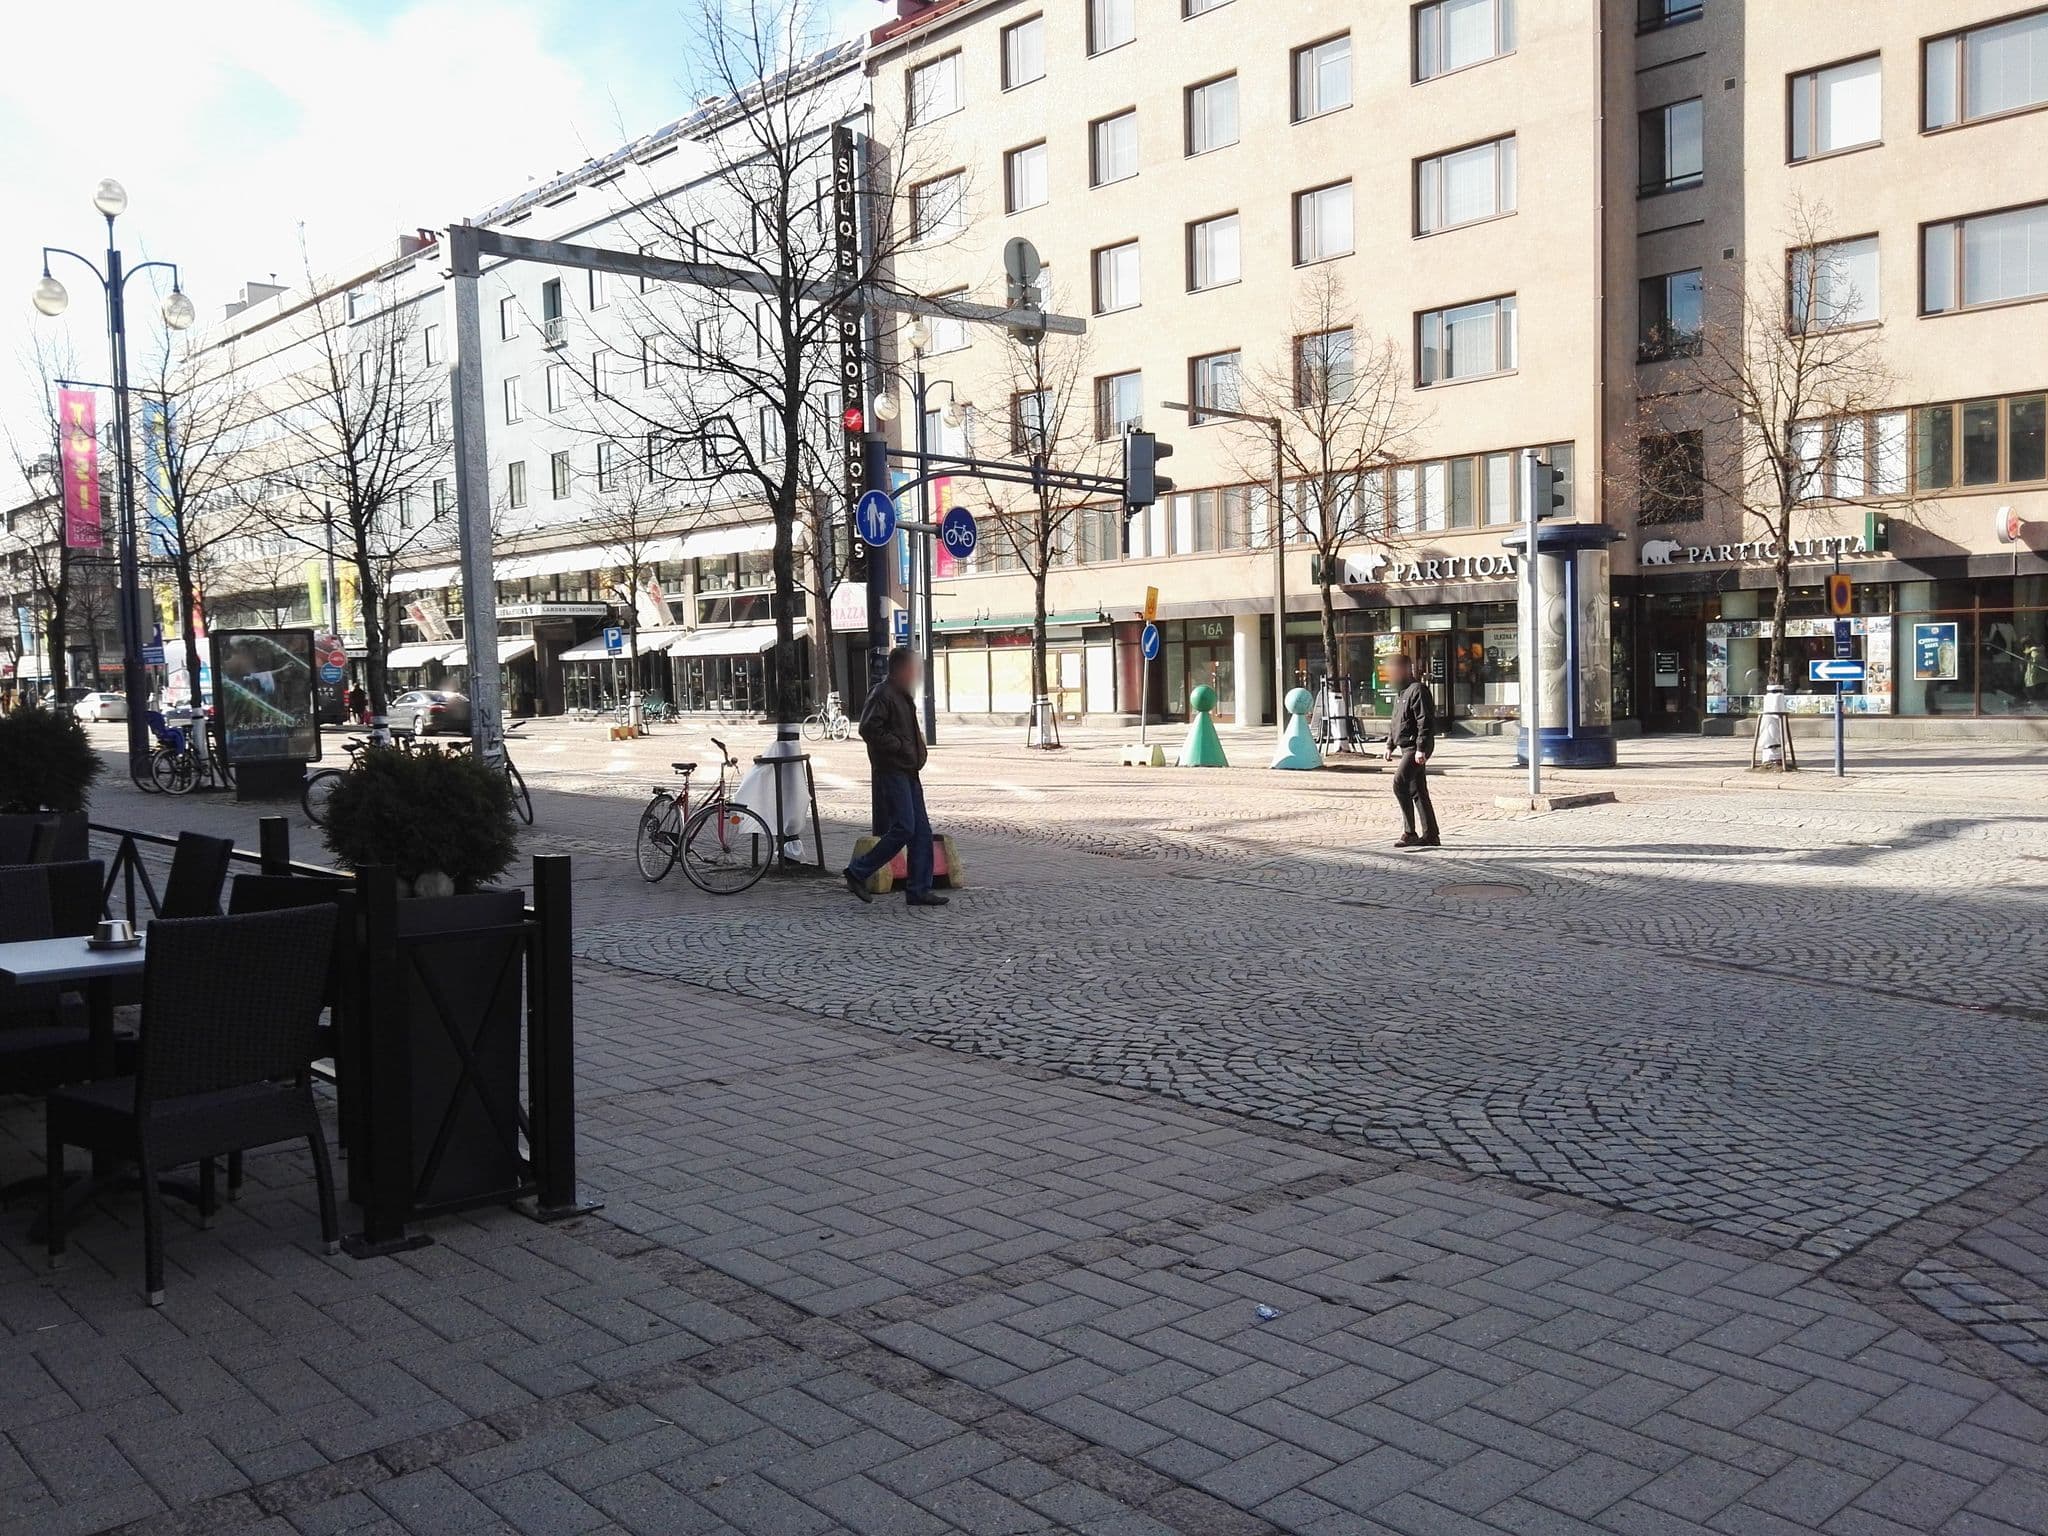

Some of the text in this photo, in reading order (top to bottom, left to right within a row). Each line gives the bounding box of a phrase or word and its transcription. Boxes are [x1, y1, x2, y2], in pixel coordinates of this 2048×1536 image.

[837, 157, 853, 239] SOLO
[1393, 553, 1517, 582] PARTIOA
[898, 611, 908, 633] P
[1200, 622, 1223, 635] 16A
[608, 630, 619, 647] P
